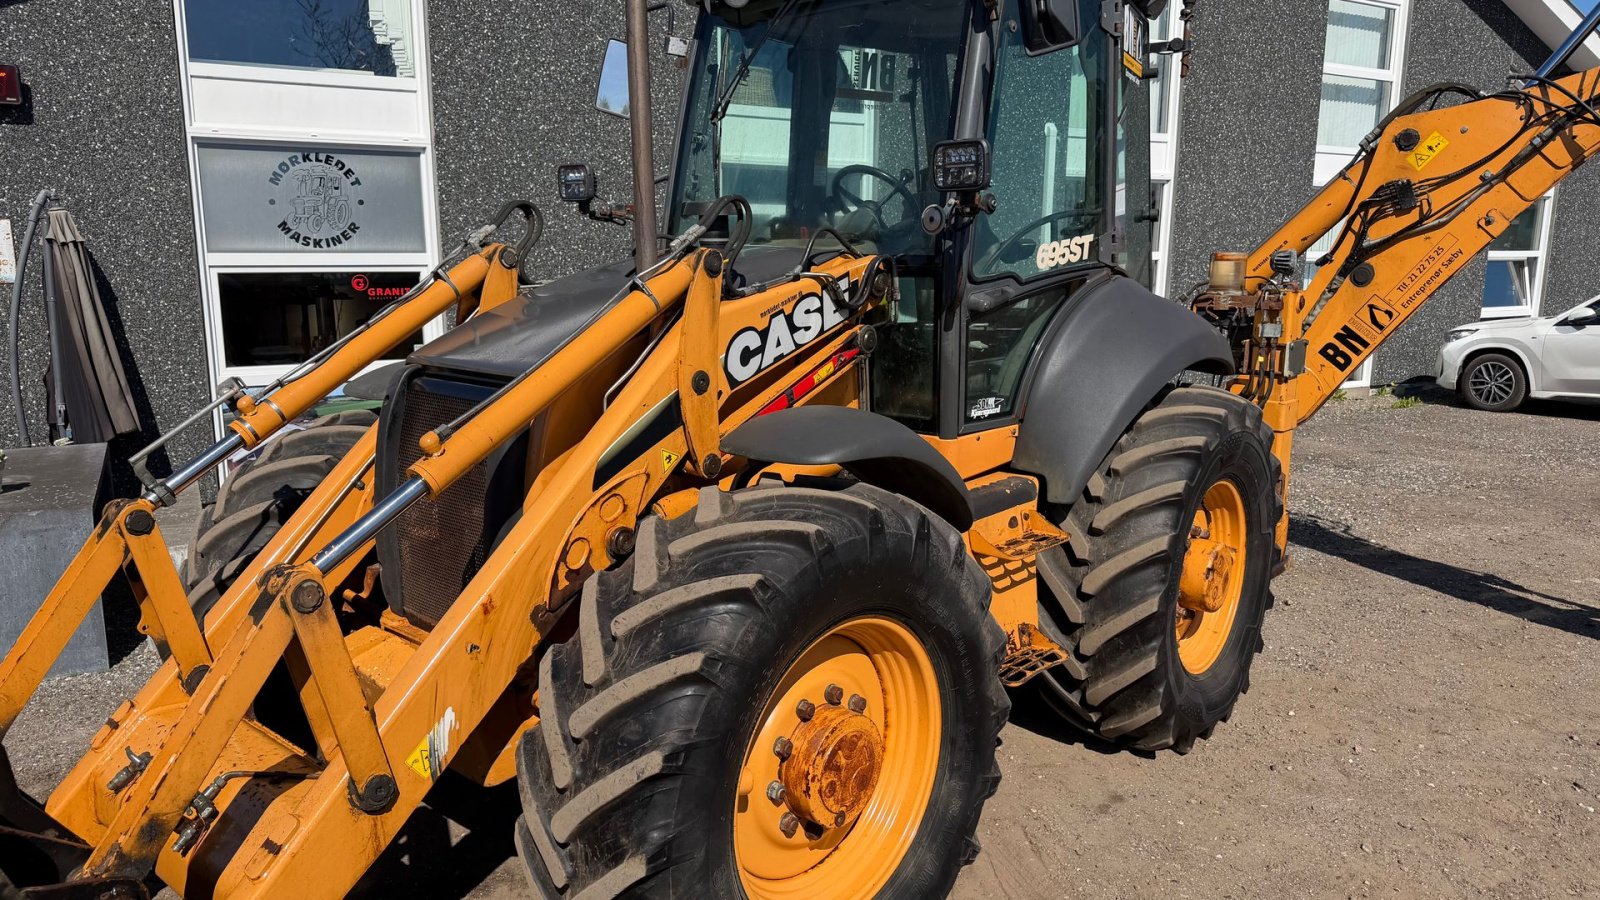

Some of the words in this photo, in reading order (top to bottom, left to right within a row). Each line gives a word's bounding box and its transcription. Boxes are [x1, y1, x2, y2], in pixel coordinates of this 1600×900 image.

[268, 152, 362, 186] MØRKLEDET
[277, 220, 360, 248] MASKINER
[1036, 233, 1095, 270] 695ST
[1397, 281, 1410, 293] Tlf.
[1407, 273, 1418, 283] 21
[1416, 263, 1427, 274] 22
[1425, 254, 1436, 265] 75
[1433, 245, 1445, 257] 25
[1401, 268, 1443, 309] Entreprenør
[1441, 248, 1464, 269] Sæby
[1317, 324, 1371, 373] BN
